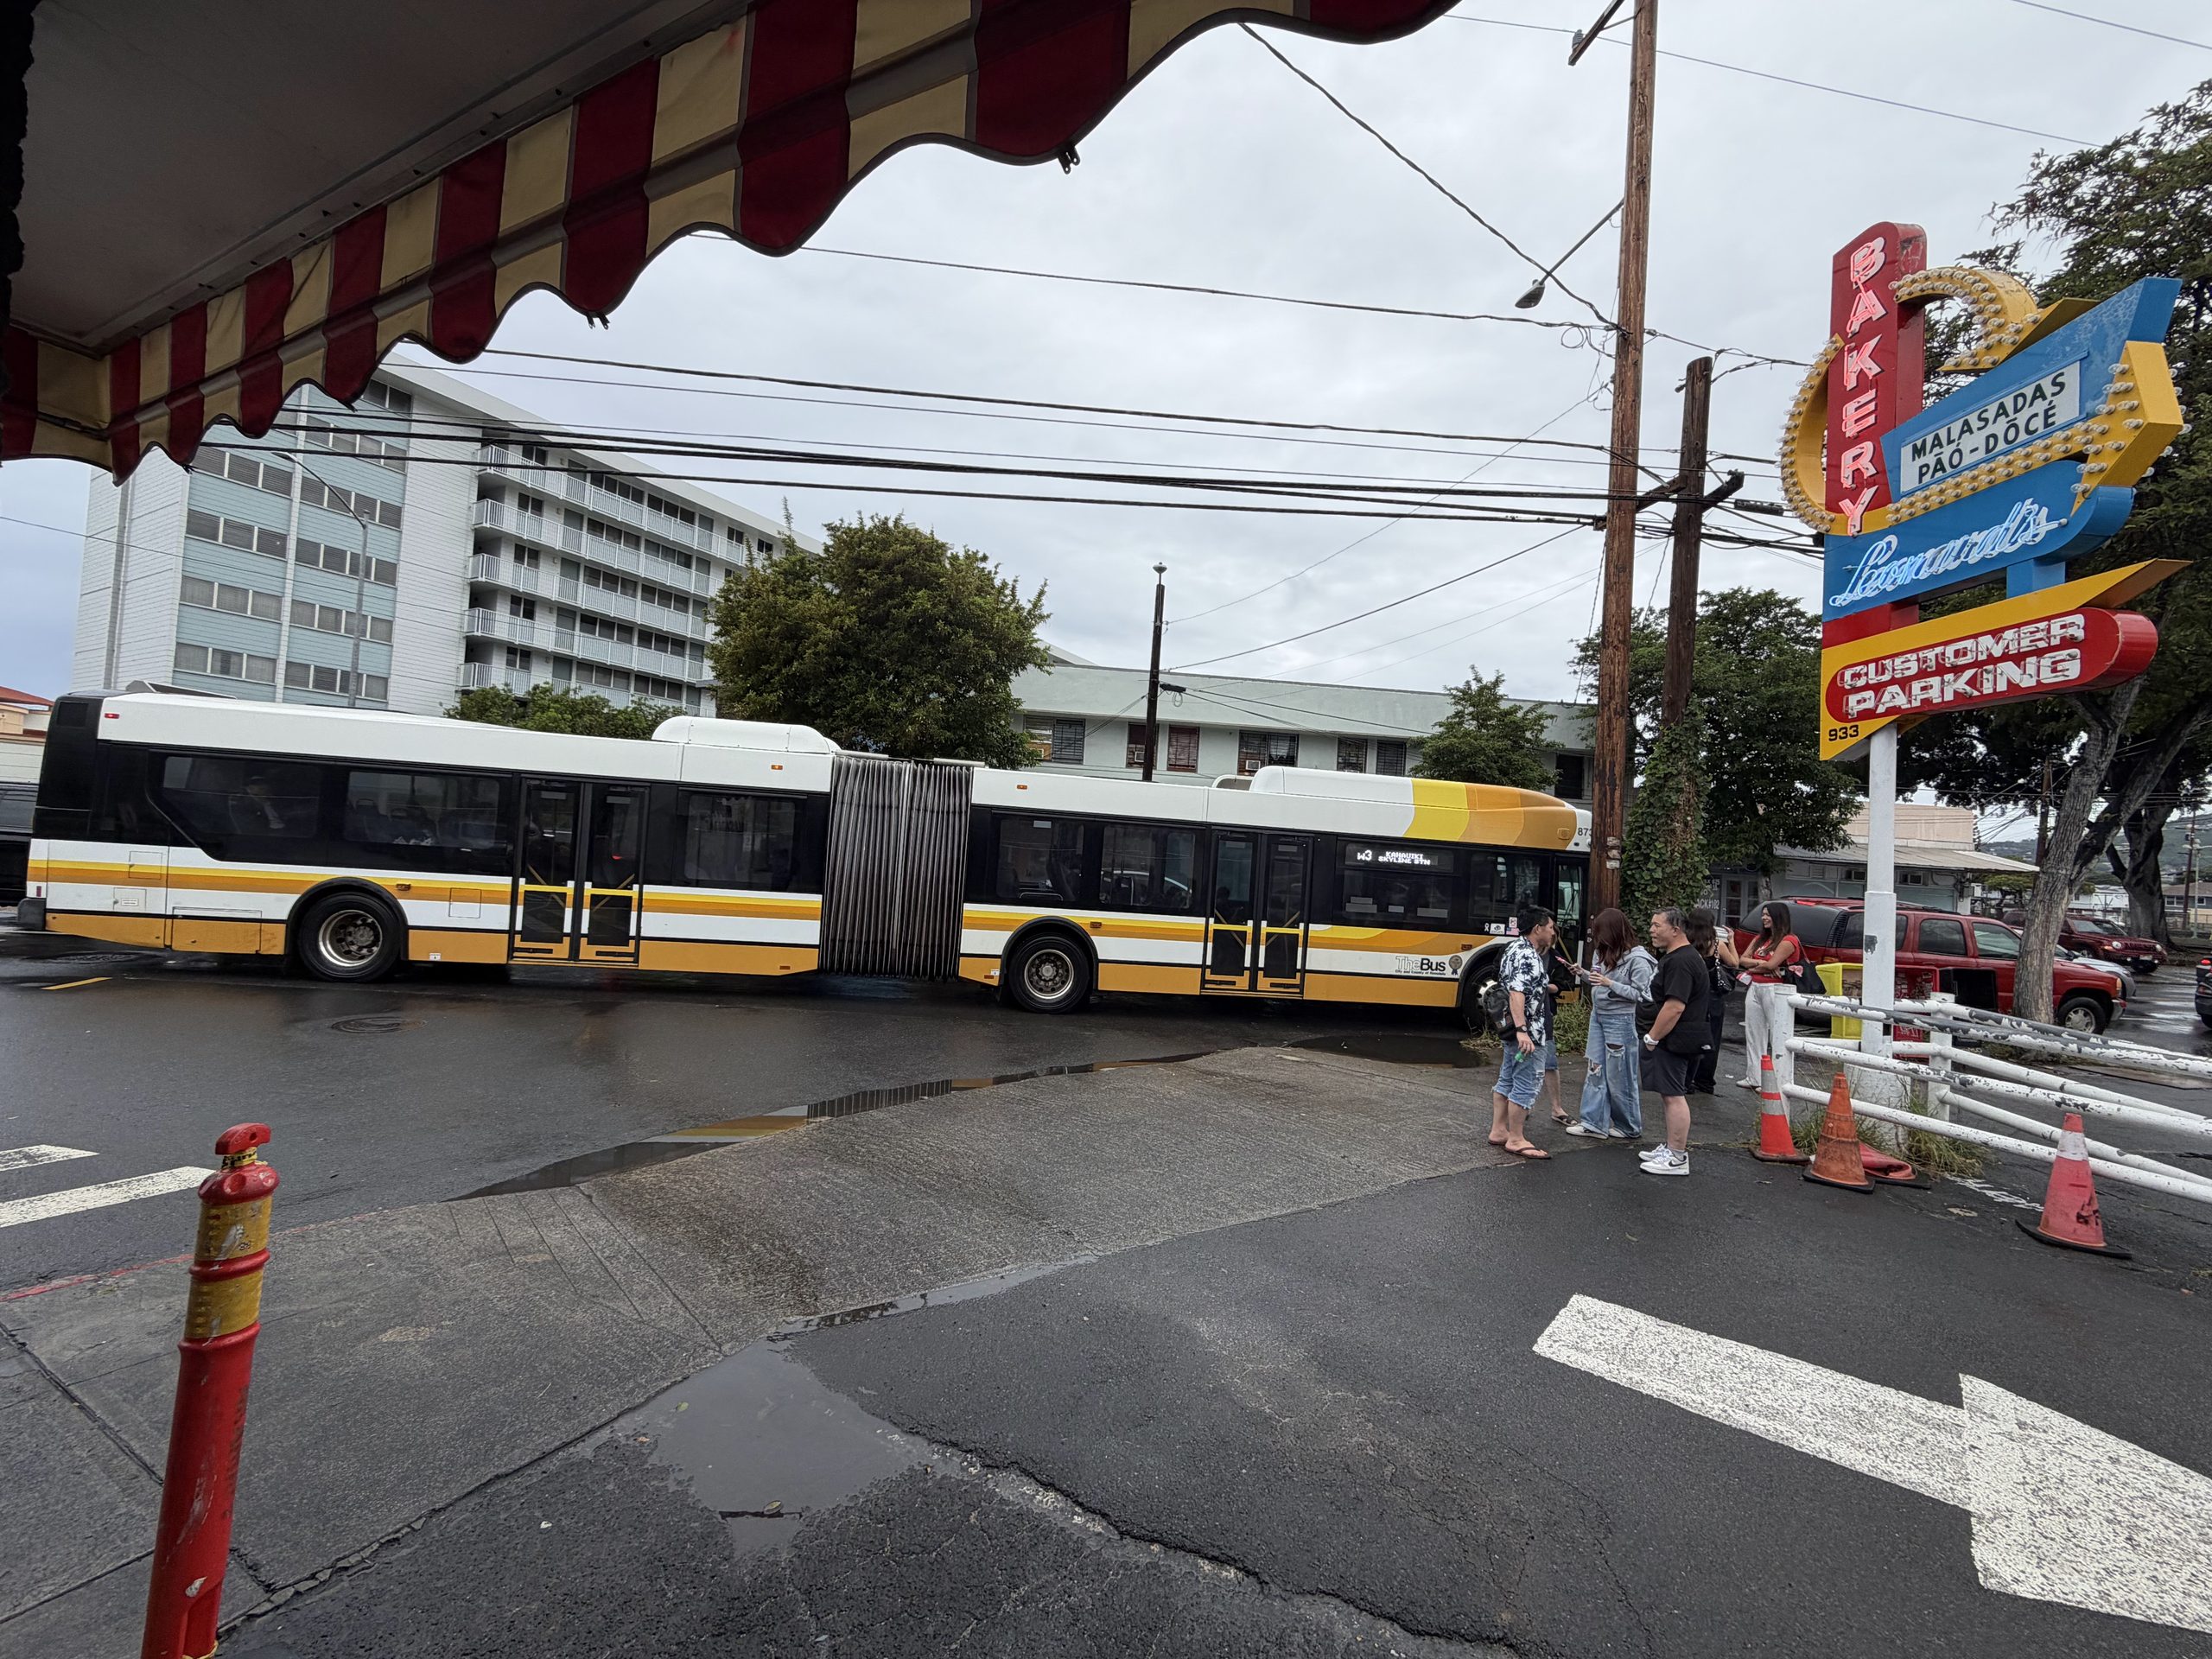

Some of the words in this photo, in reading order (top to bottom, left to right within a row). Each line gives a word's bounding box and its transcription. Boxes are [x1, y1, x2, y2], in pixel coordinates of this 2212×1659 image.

[1839, 236, 1887, 537] BAKERY
[1911, 372, 2066, 462] MALASADAS
[1829, 498, 2067, 607] Leonard's
[1837, 613, 2085, 690] CUSTOMER
[1843, 648, 2082, 719] PARKING
[1828, 724, 1859, 741] 933
[1395, 956, 1446, 972] TheBus
